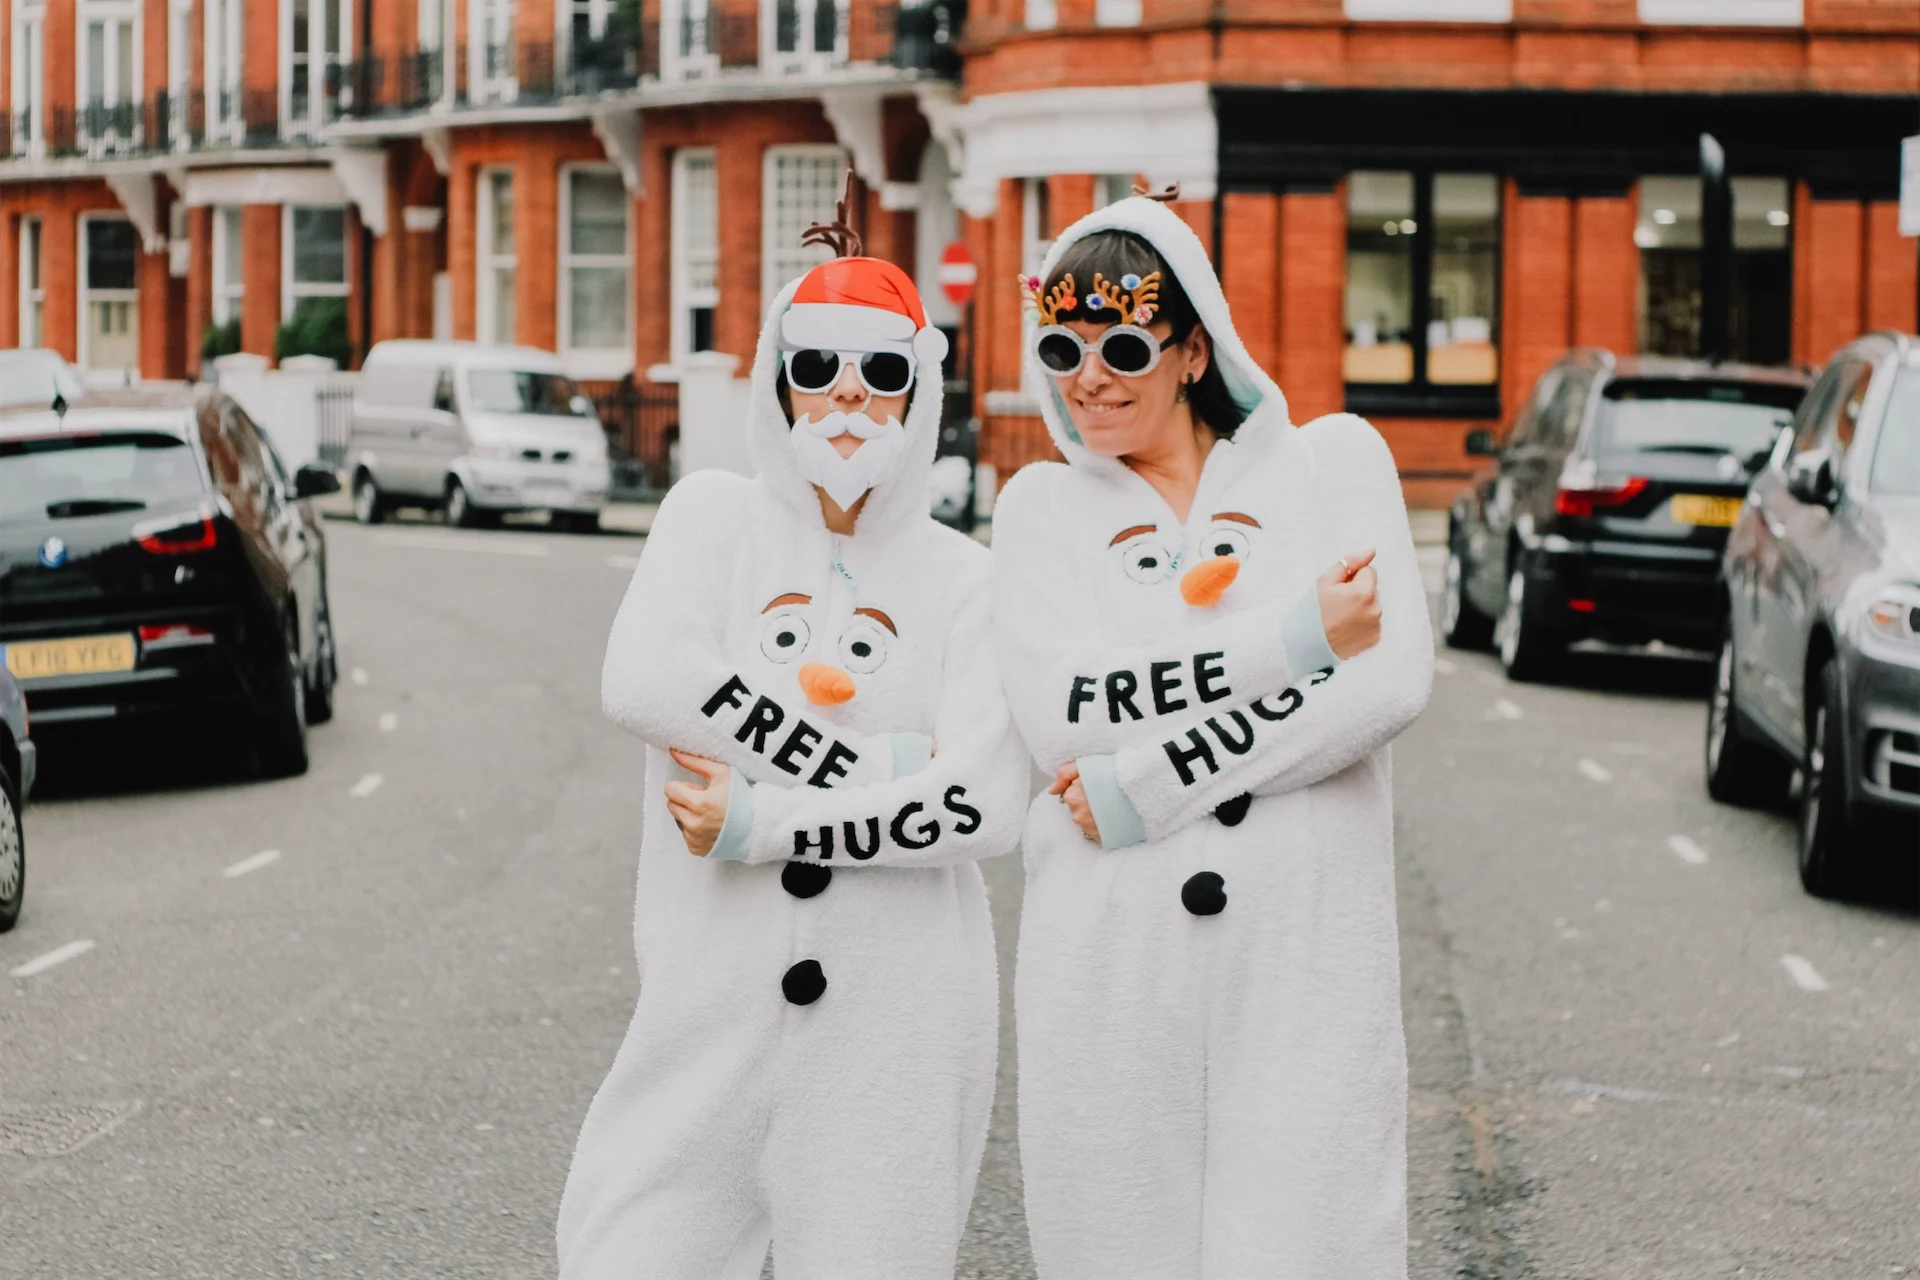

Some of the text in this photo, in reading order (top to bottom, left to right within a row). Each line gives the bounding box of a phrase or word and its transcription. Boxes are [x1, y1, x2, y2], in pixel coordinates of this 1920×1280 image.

[1067, 651, 1232, 724] FREE
[701, 674, 859, 789] FREE
[793, 785, 982, 861] HUGS
